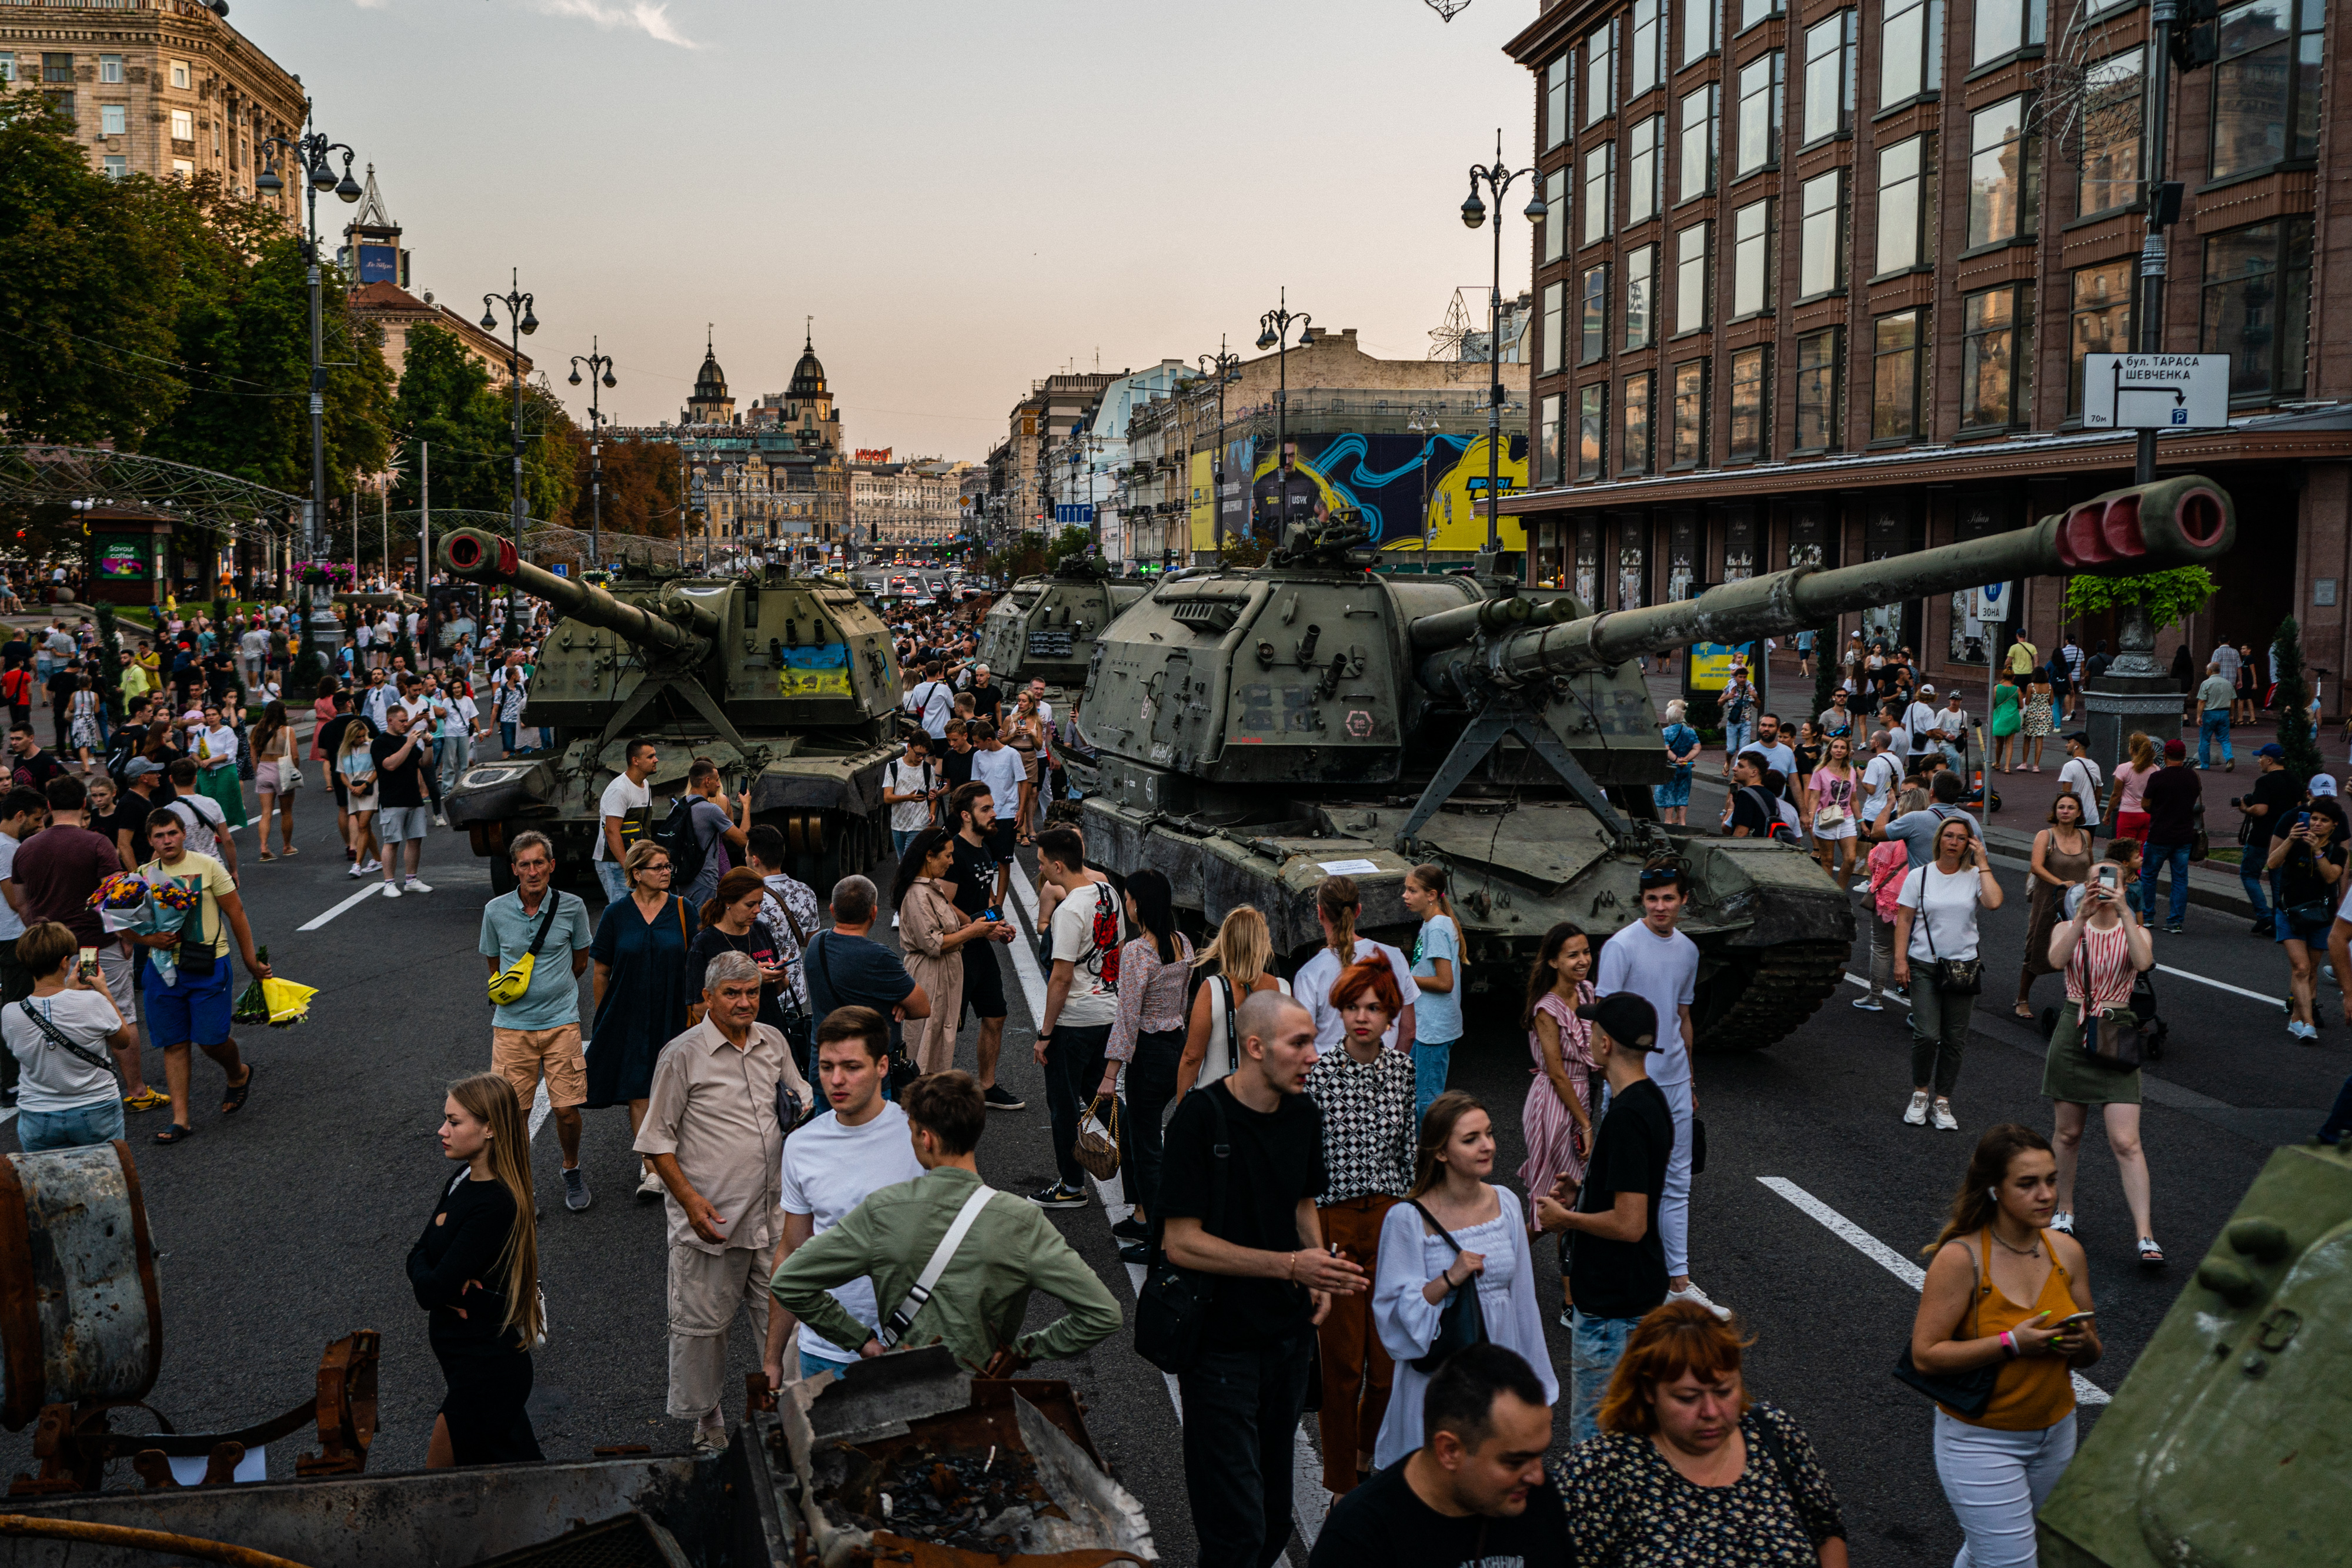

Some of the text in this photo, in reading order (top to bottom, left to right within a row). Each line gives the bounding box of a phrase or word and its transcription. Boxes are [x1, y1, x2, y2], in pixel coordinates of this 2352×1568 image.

[2126, 356, 2200, 368] бул. ТАРАСА
[2126, 370, 2191, 380] ШЕВЧЕНКА
[598, 426, 640, 437] ARENA
[856, 449, 888, 462] HUGO
[1292, 496, 1307, 504] USYK
[1983, 607, 2000, 617] ЗОНА
[32, 1012, 69, 1045] BALENCIAGA
[73, 1047, 105, 1067] BALENCIAGA
